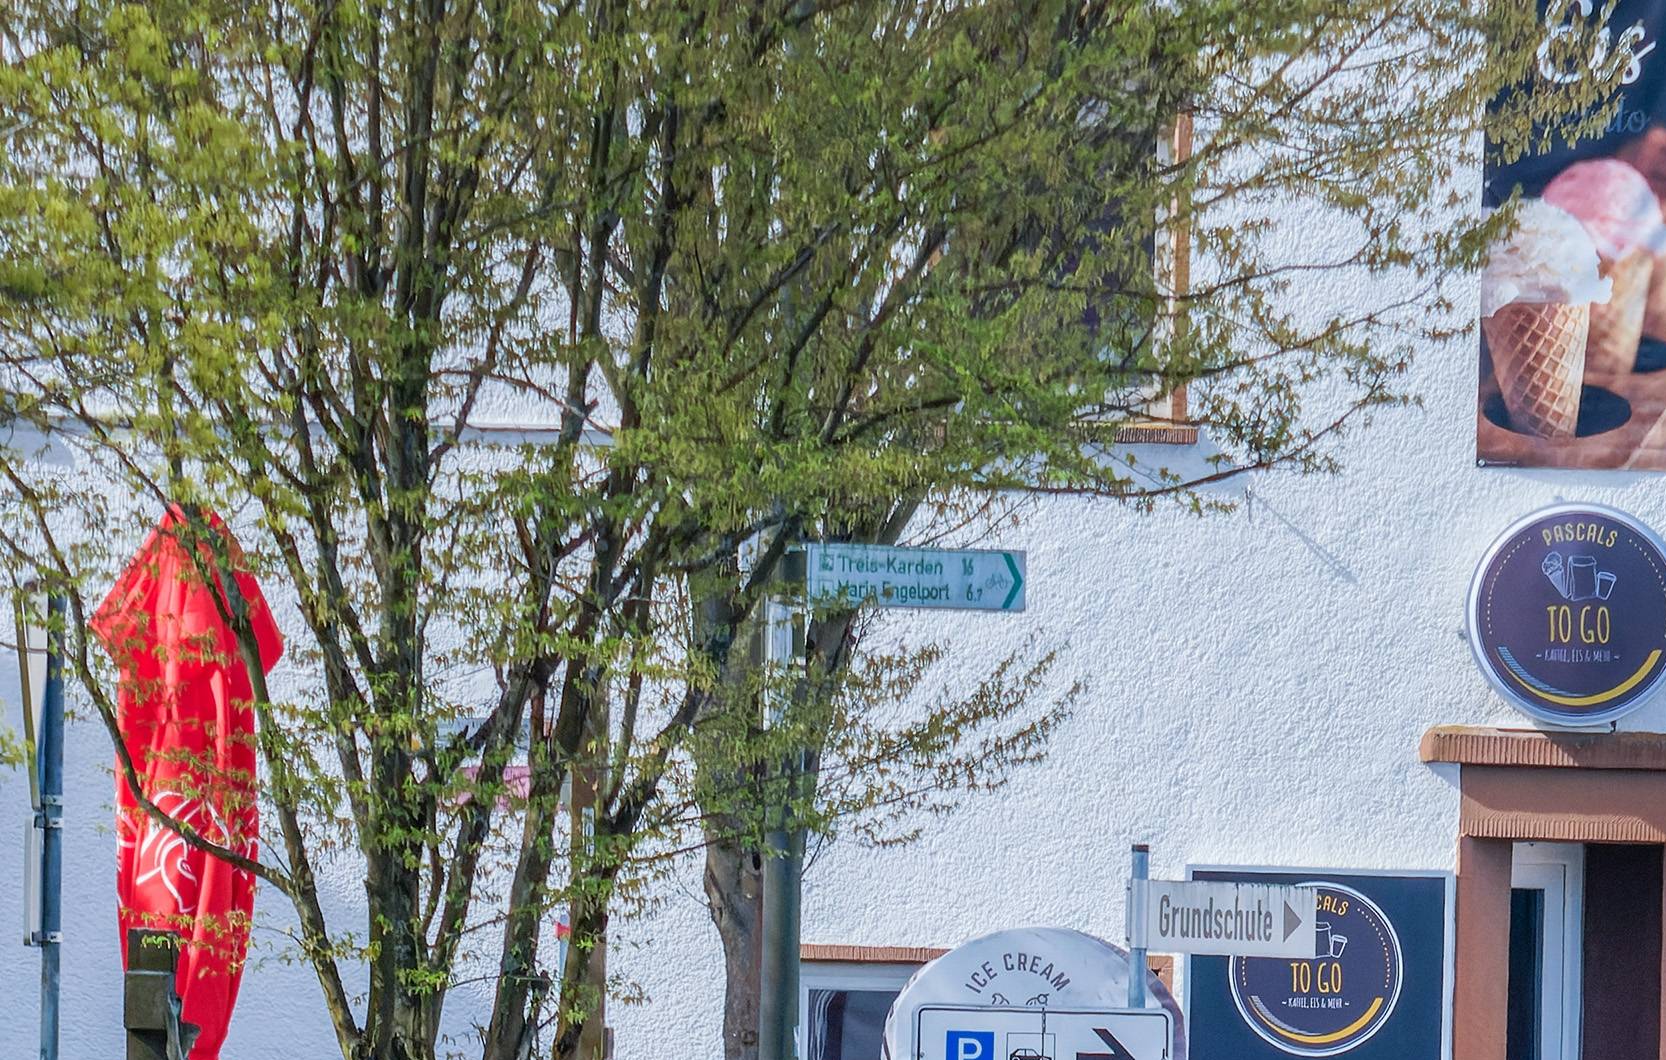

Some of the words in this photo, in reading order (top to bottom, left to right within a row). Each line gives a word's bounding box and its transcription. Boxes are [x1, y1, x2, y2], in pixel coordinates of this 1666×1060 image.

[1542, 523, 1617, 547] PASCALS
[962, 557, 974, 576] 16
[1547, 605, 1571, 643] TO
[1580, 606, 1610, 644] GO
[1315, 894, 1349, 916] CALS
[965, 961, 998, 994] ICE
[1003, 952, 1071, 992] CREAM
[1290, 962, 1311, 993] TO
[1317, 962, 1342, 993] GO
